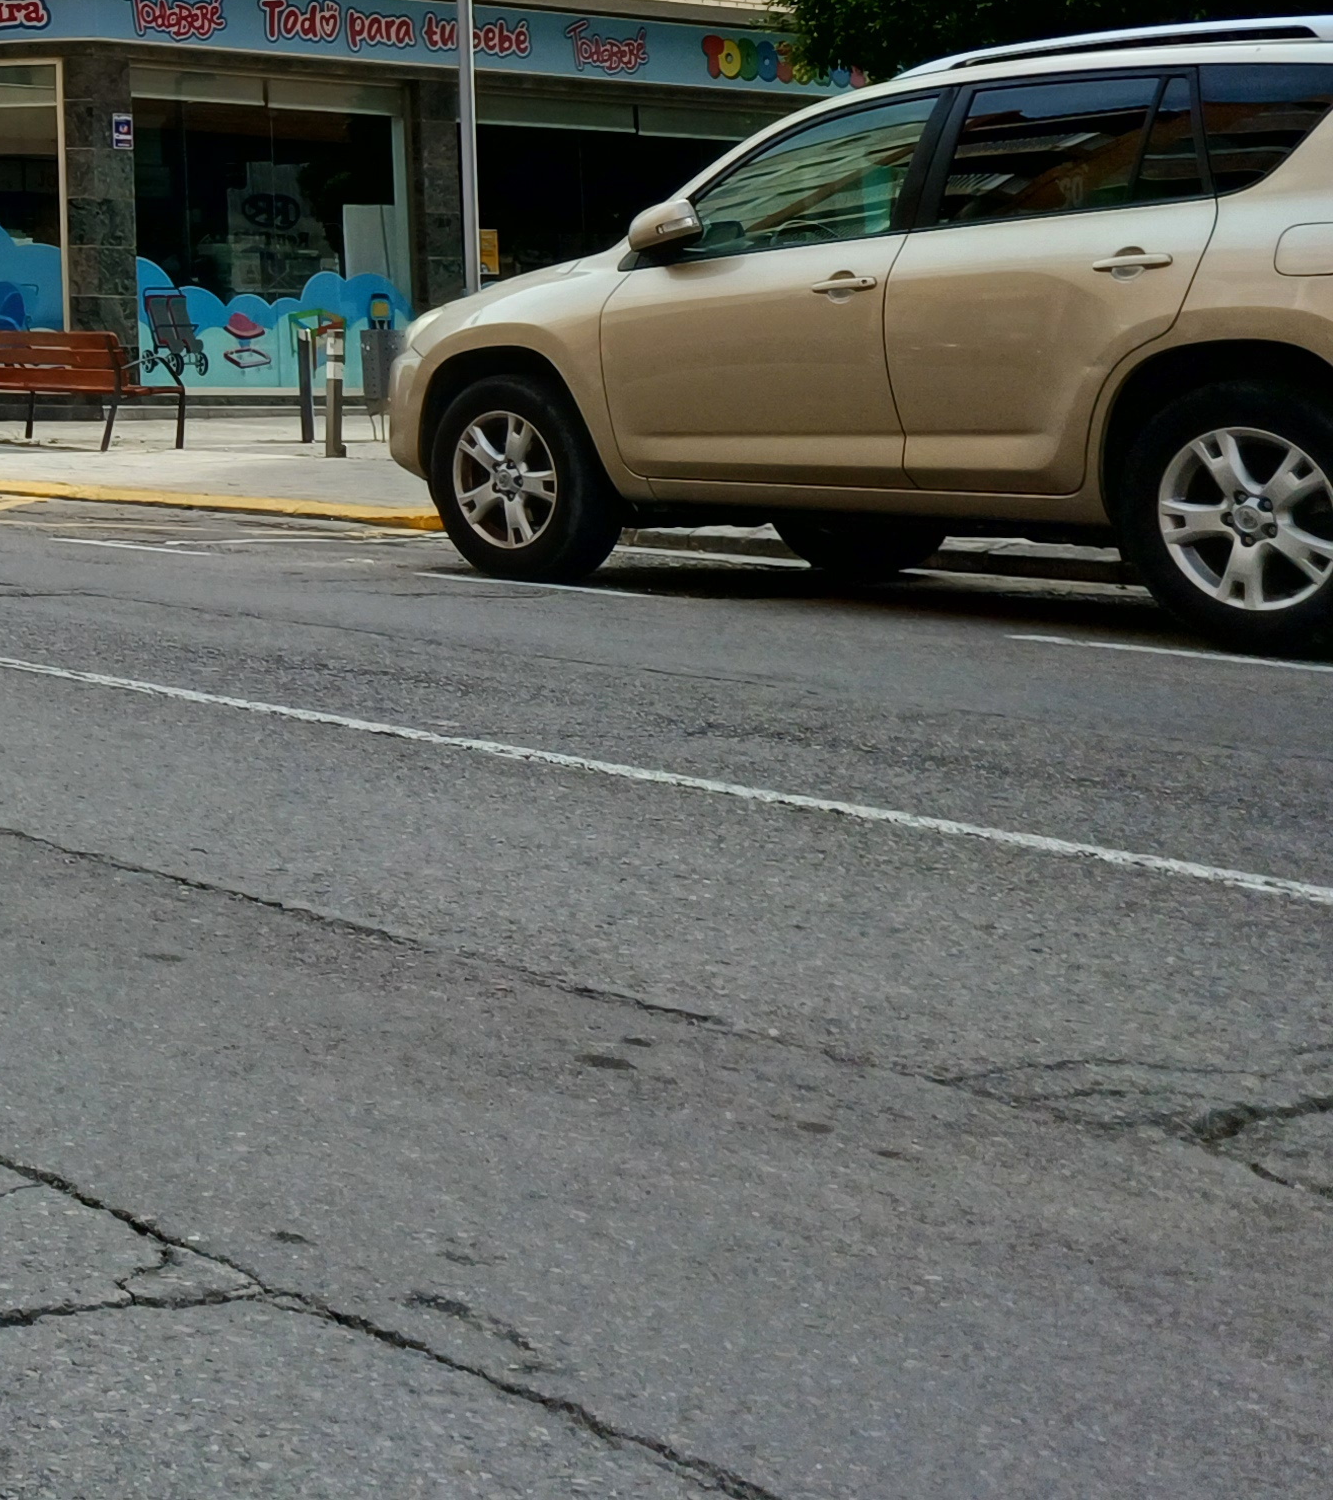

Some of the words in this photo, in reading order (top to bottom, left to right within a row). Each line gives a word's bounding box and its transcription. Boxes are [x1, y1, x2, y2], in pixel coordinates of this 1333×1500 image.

[262, 0, 339, 40] Todo
[347, 8, 414, 51] para
[422, 13, 457, 51] tu
